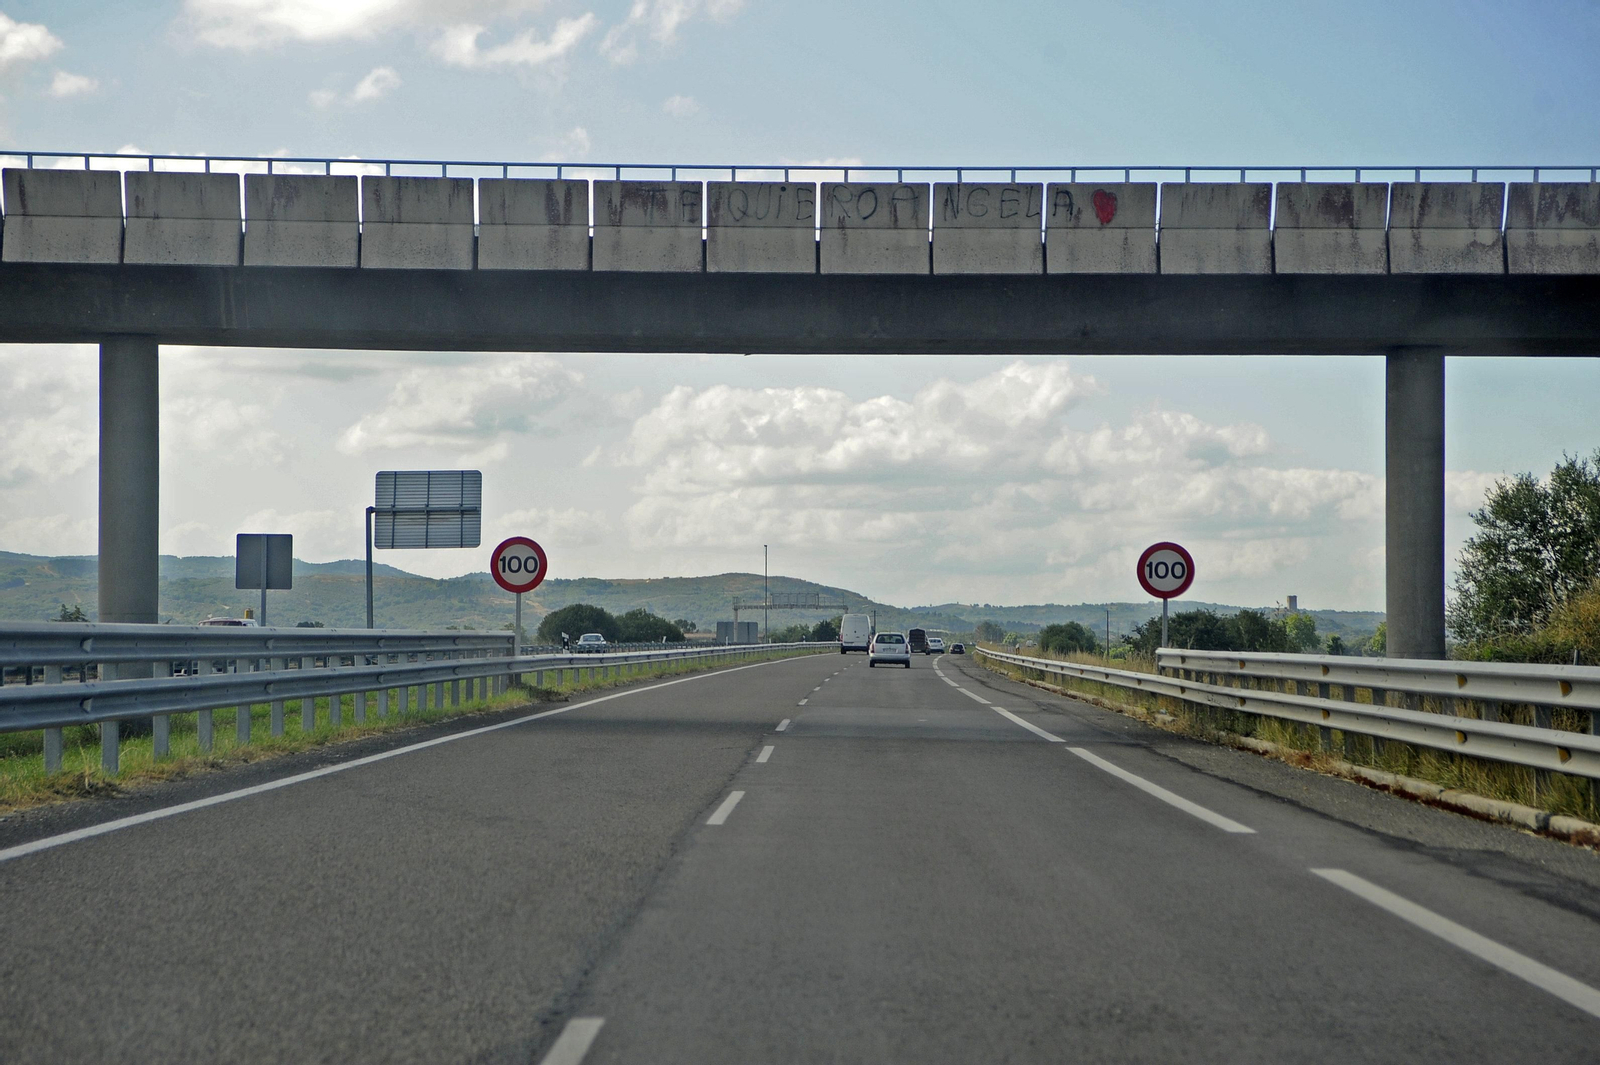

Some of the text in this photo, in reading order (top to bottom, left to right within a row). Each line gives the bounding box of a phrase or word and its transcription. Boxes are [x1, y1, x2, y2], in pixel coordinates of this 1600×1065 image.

[892, 185, 1074, 222] ANGELA
[500, 555, 539, 574] 100
[1146, 561, 1186, 580] 100
